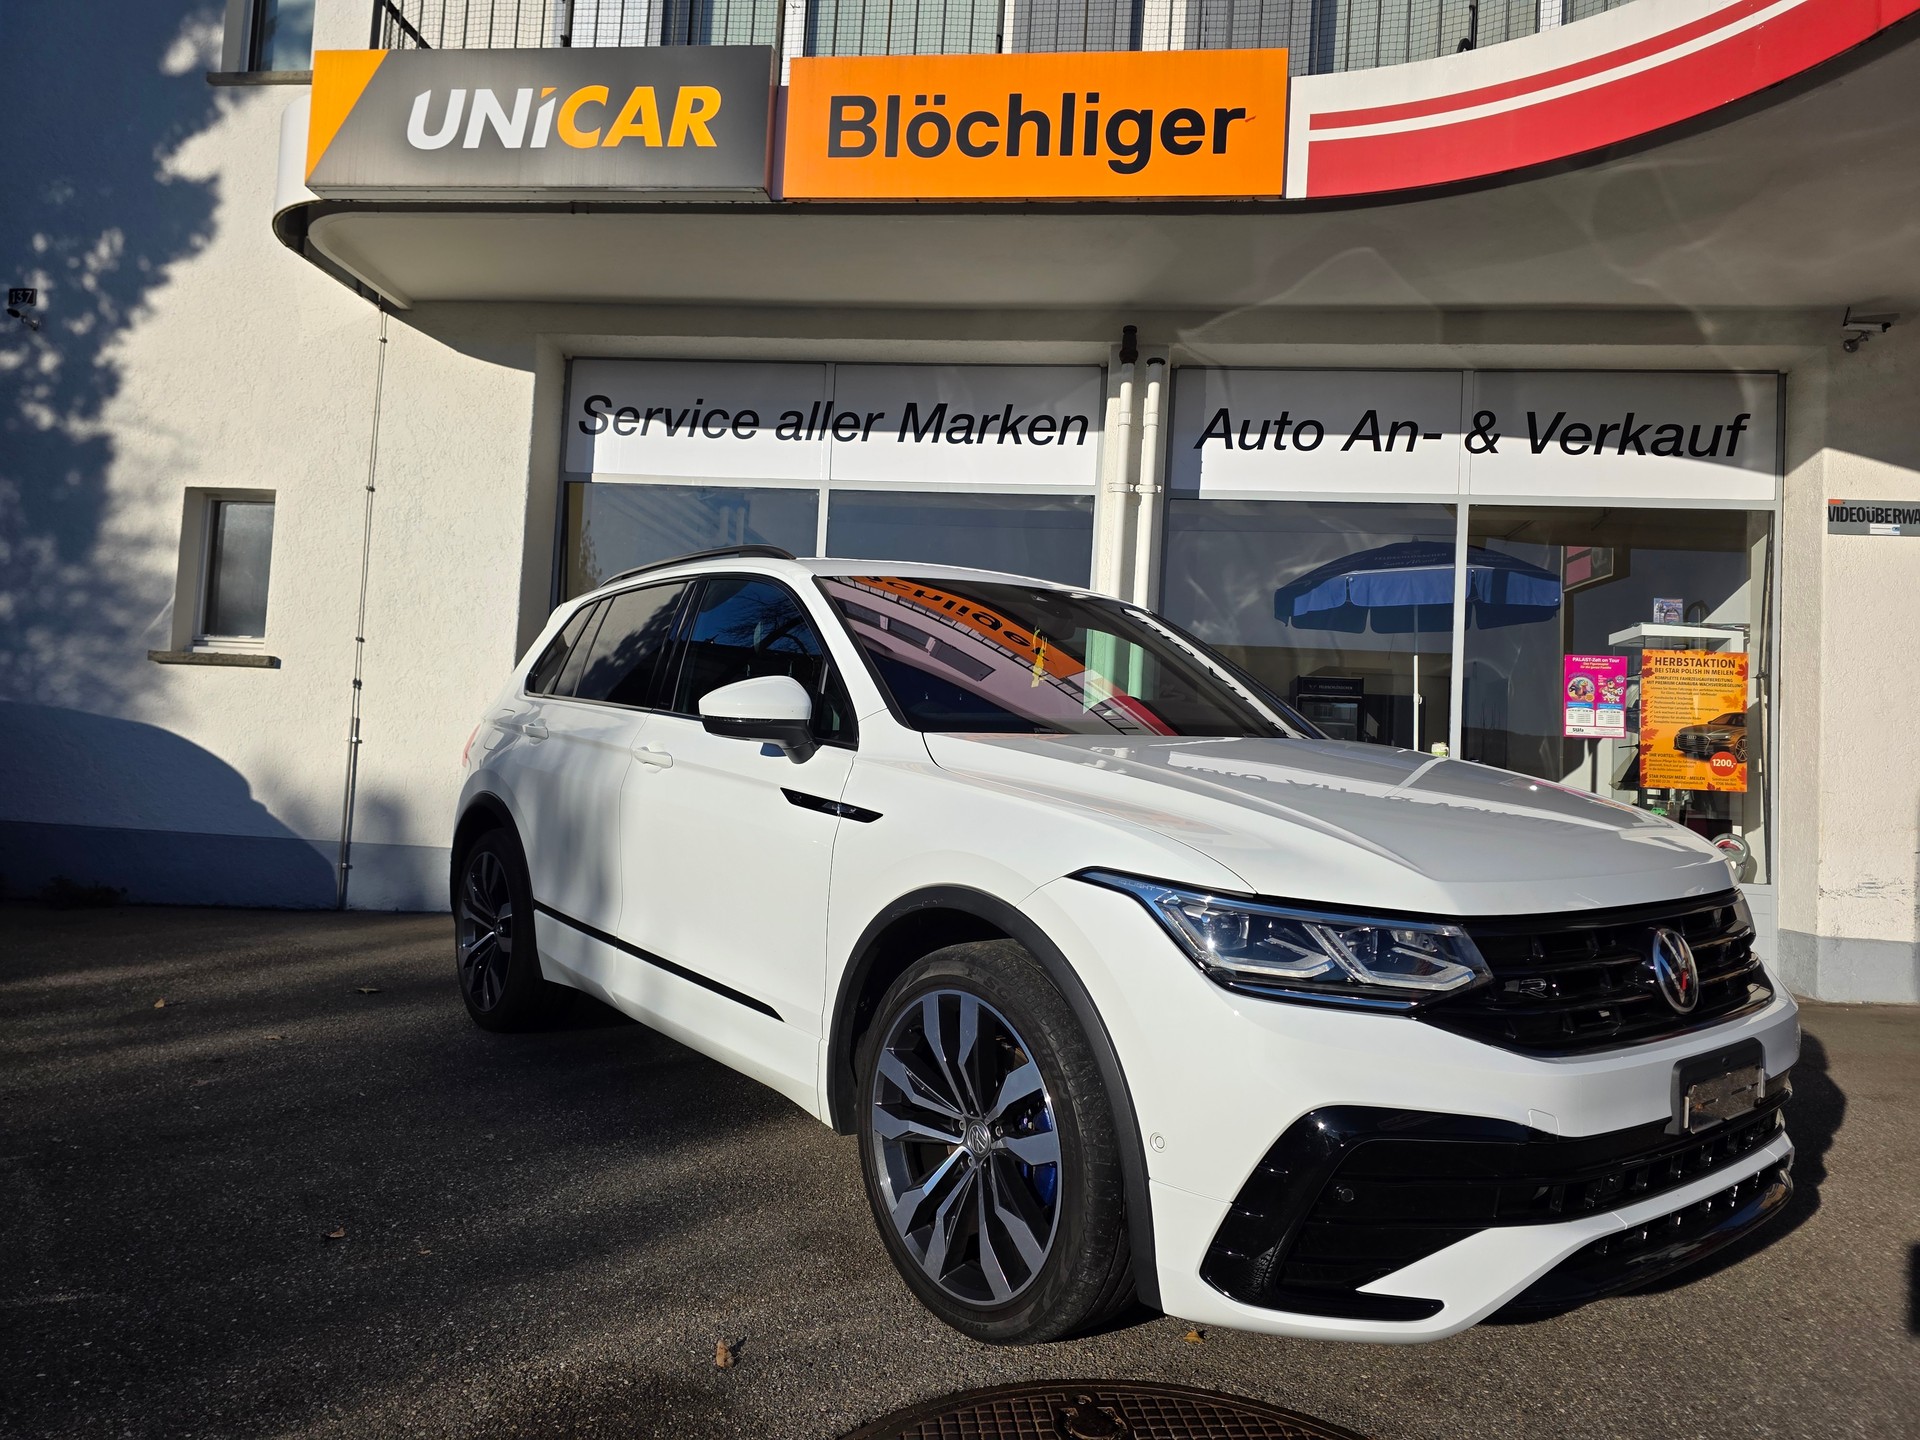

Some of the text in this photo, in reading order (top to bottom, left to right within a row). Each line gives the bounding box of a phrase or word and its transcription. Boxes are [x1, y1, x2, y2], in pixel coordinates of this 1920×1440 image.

[827, 92, 1246, 175] Blöchliger
[578, 395, 1089, 447] Service aller Marken
[1194, 407, 1752, 458] Auto An- & Verkauf
[1655, 657, 1735, 668] HERBSTAKTION
[1712, 758, 1736, 768] 1200,-
